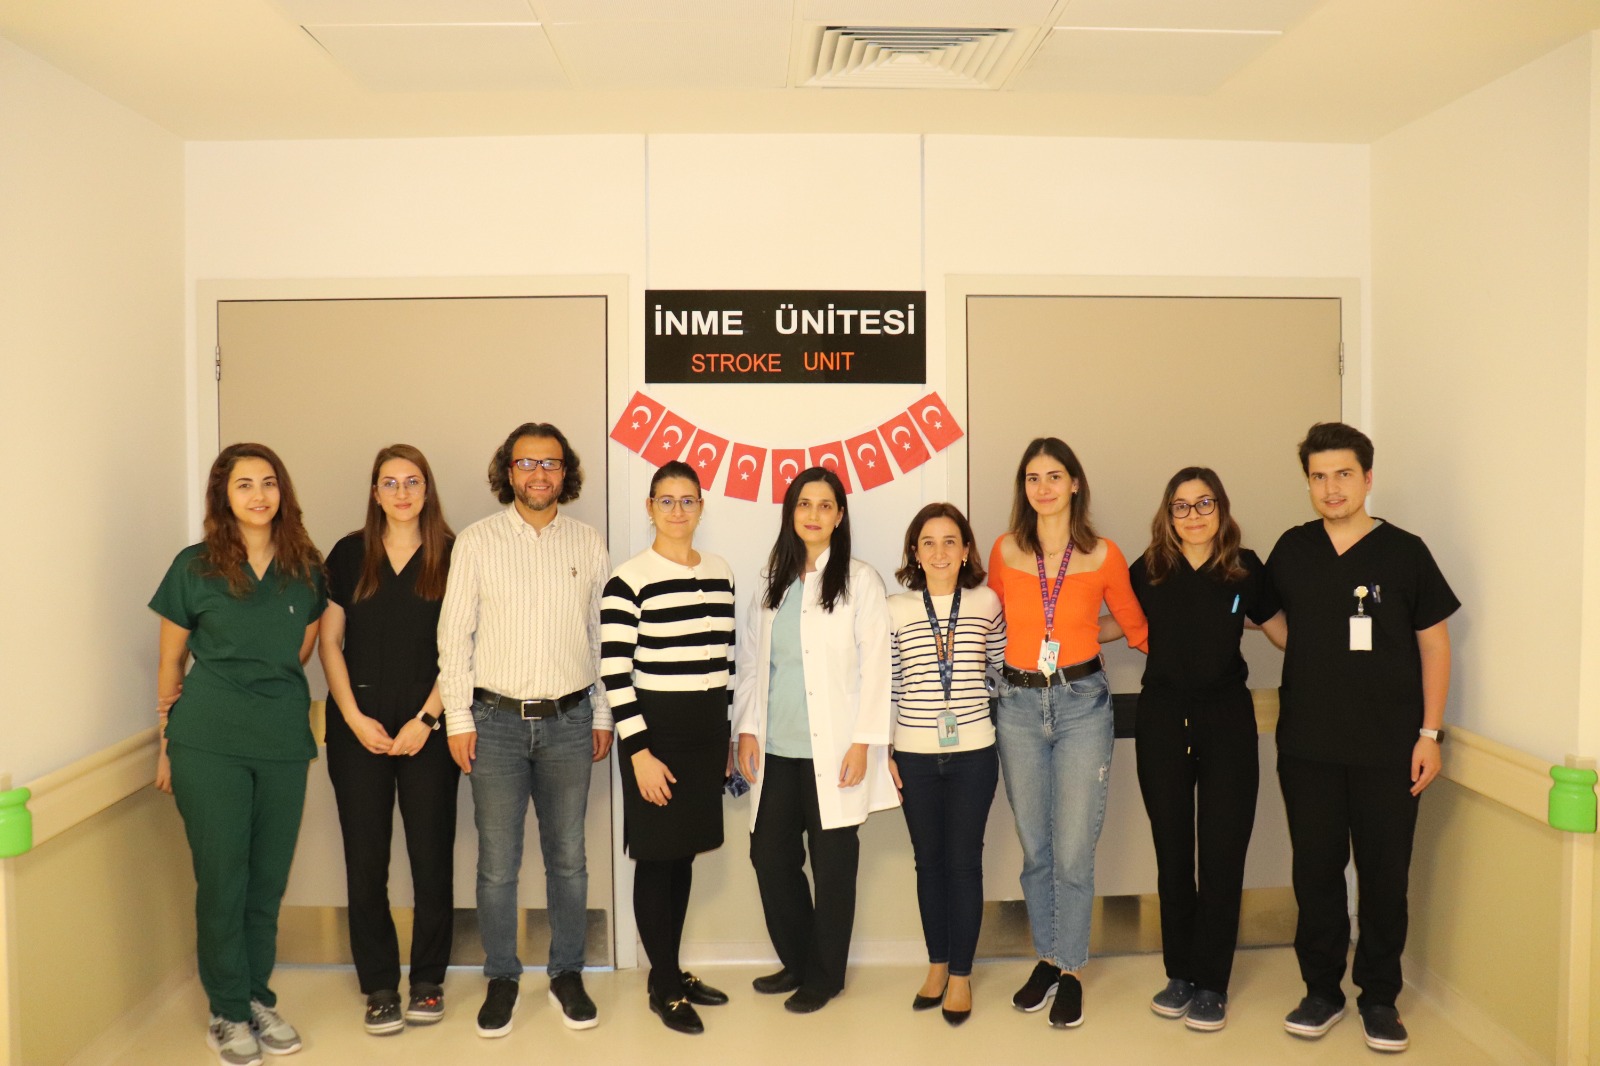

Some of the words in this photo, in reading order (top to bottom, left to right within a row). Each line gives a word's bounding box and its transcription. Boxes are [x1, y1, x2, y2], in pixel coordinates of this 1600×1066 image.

[655, 304, 744, 335] İNME
[775, 303, 915, 335] ÜNİTESİ
[691, 353, 782, 373] STROKE
[803, 351, 855, 371] UNIT
